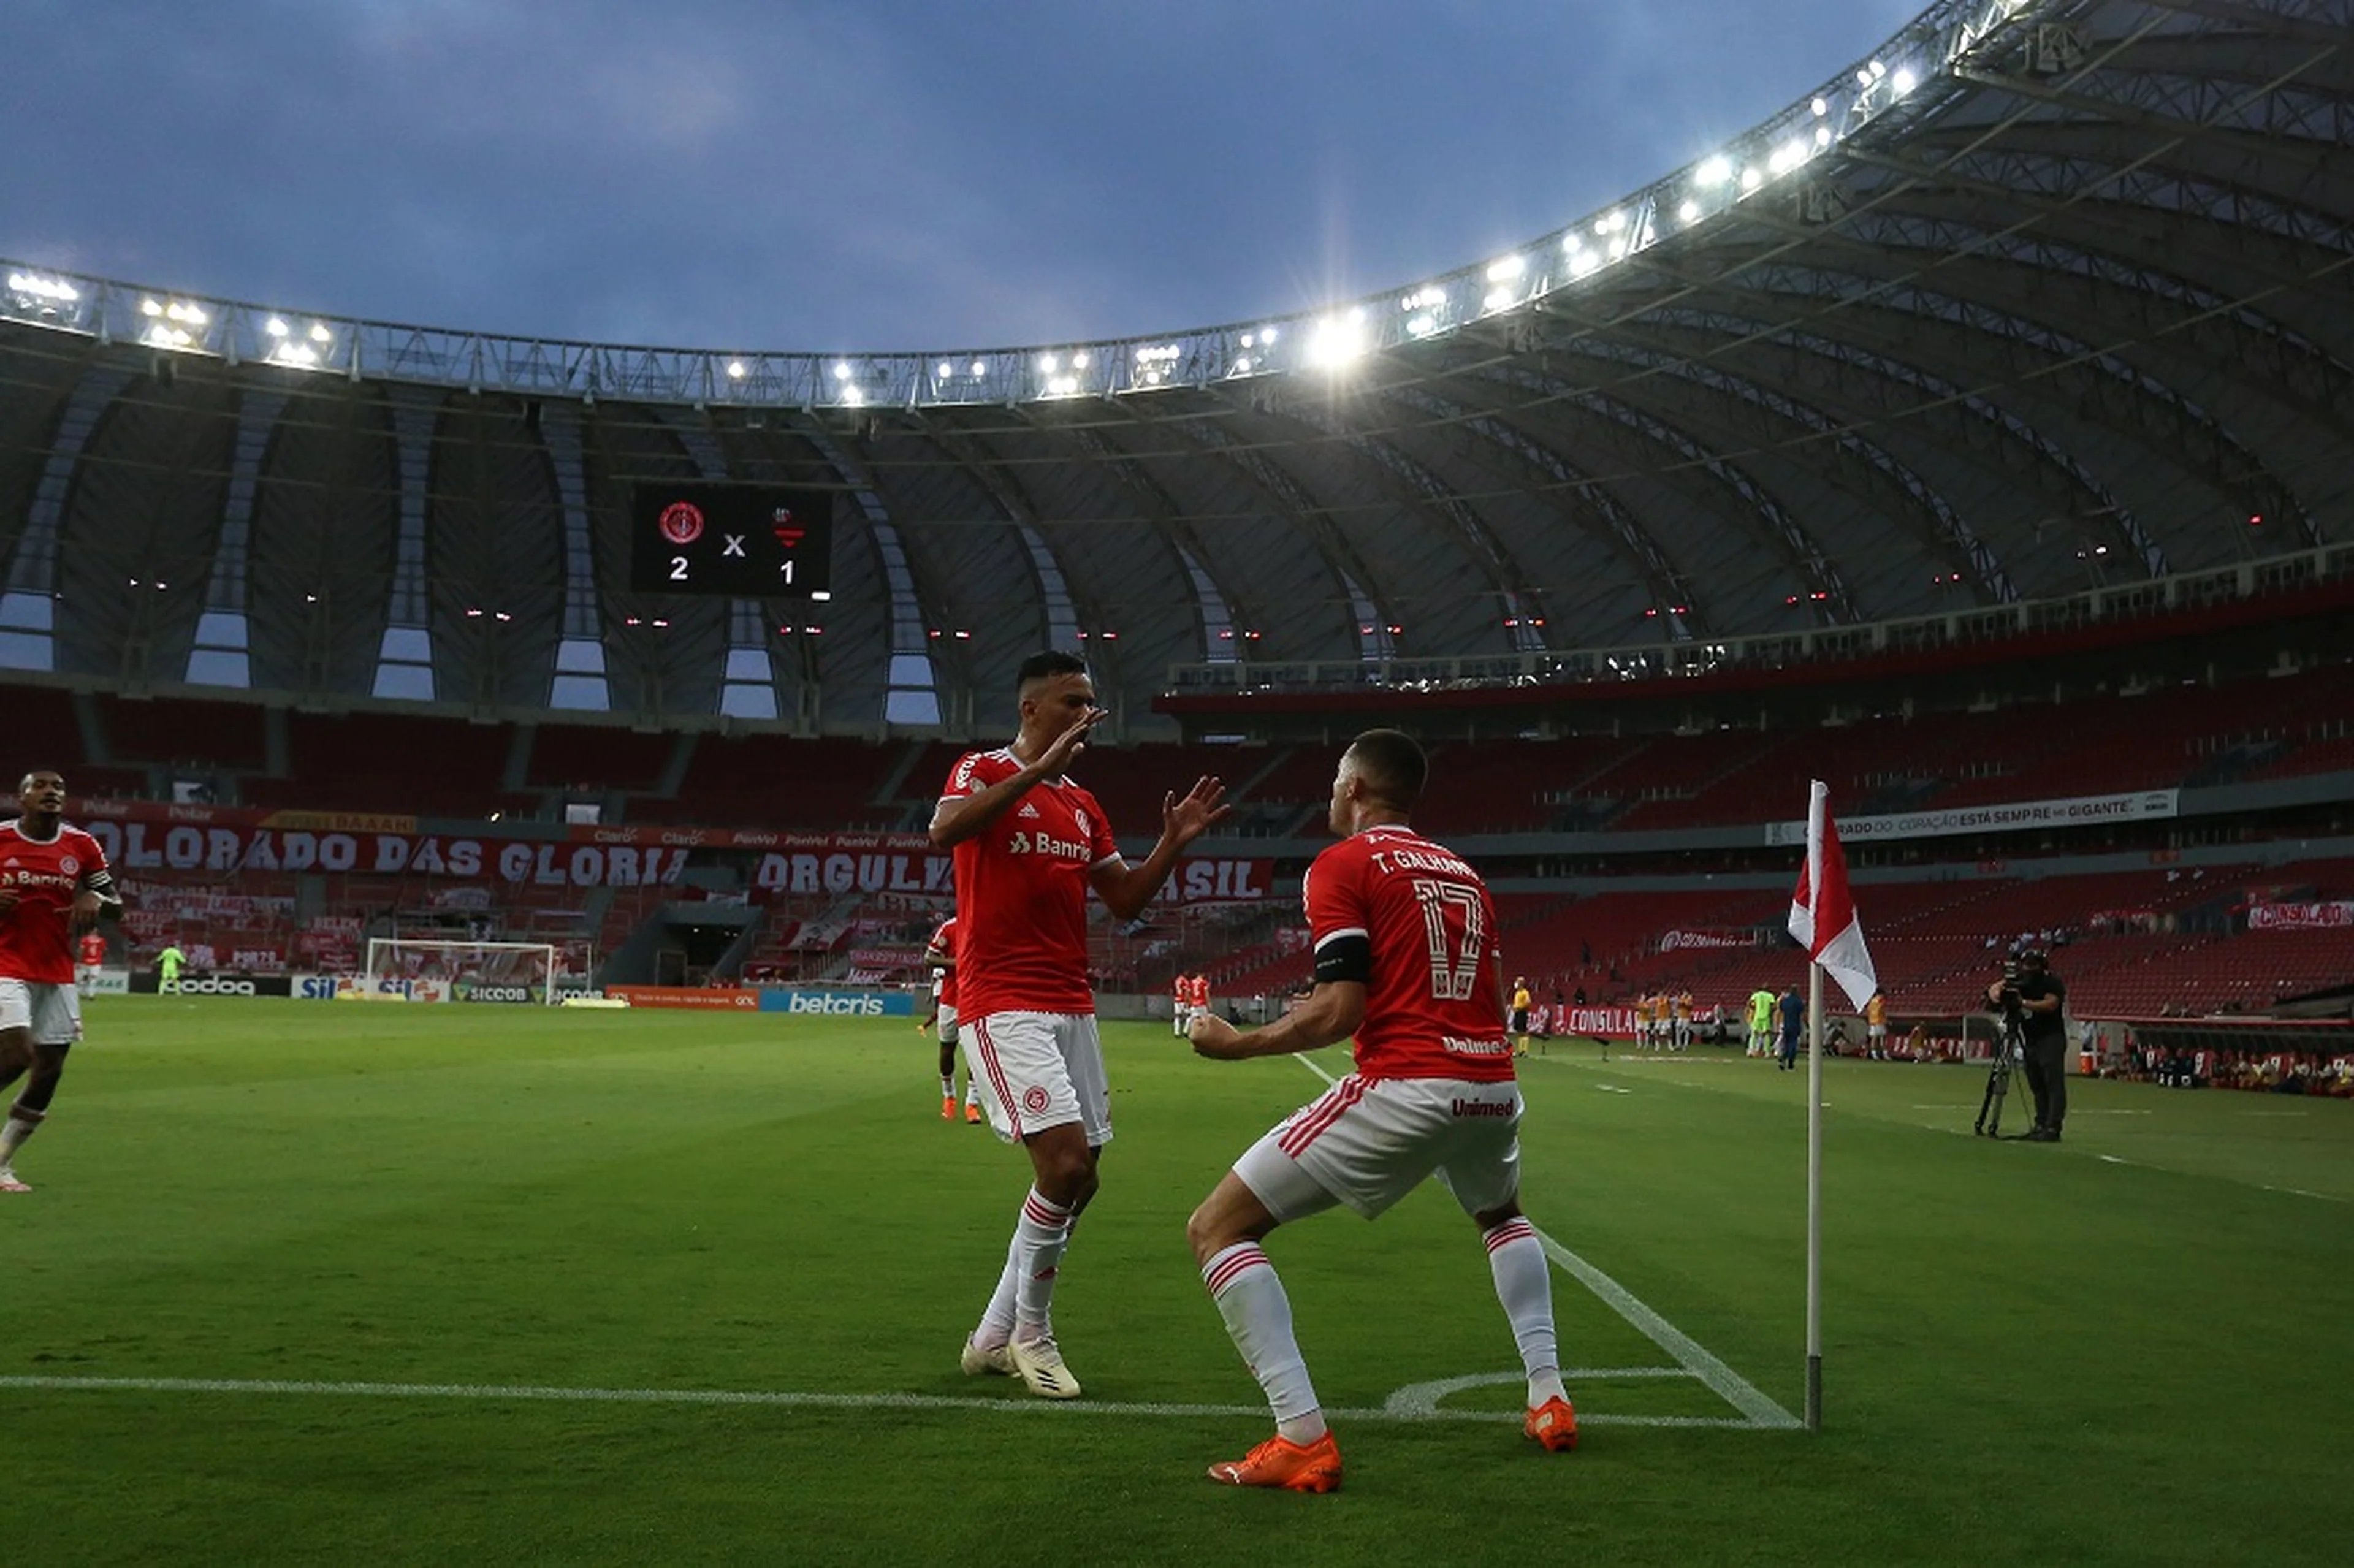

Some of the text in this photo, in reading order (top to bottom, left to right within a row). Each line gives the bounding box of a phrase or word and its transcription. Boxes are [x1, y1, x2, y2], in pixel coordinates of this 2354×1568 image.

[669, 556, 795, 585] 2 1
[1994, 802, 2051, 823] SEMPRE
[594, 830, 632, 843] Claro
[661, 832, 698, 845] Claro
[86, 821, 357, 872] OLORADO
[374, 835, 482, 875] DAS
[1372, 853, 1394, 874] T.
[1413, 879, 1480, 1000] 17
[301, 979, 335, 998] Sil
[789, 993, 883, 1015] betcris
[1570, 1008, 1643, 1035] CONSULA
[1452, 1098, 1514, 1116] Unimed
